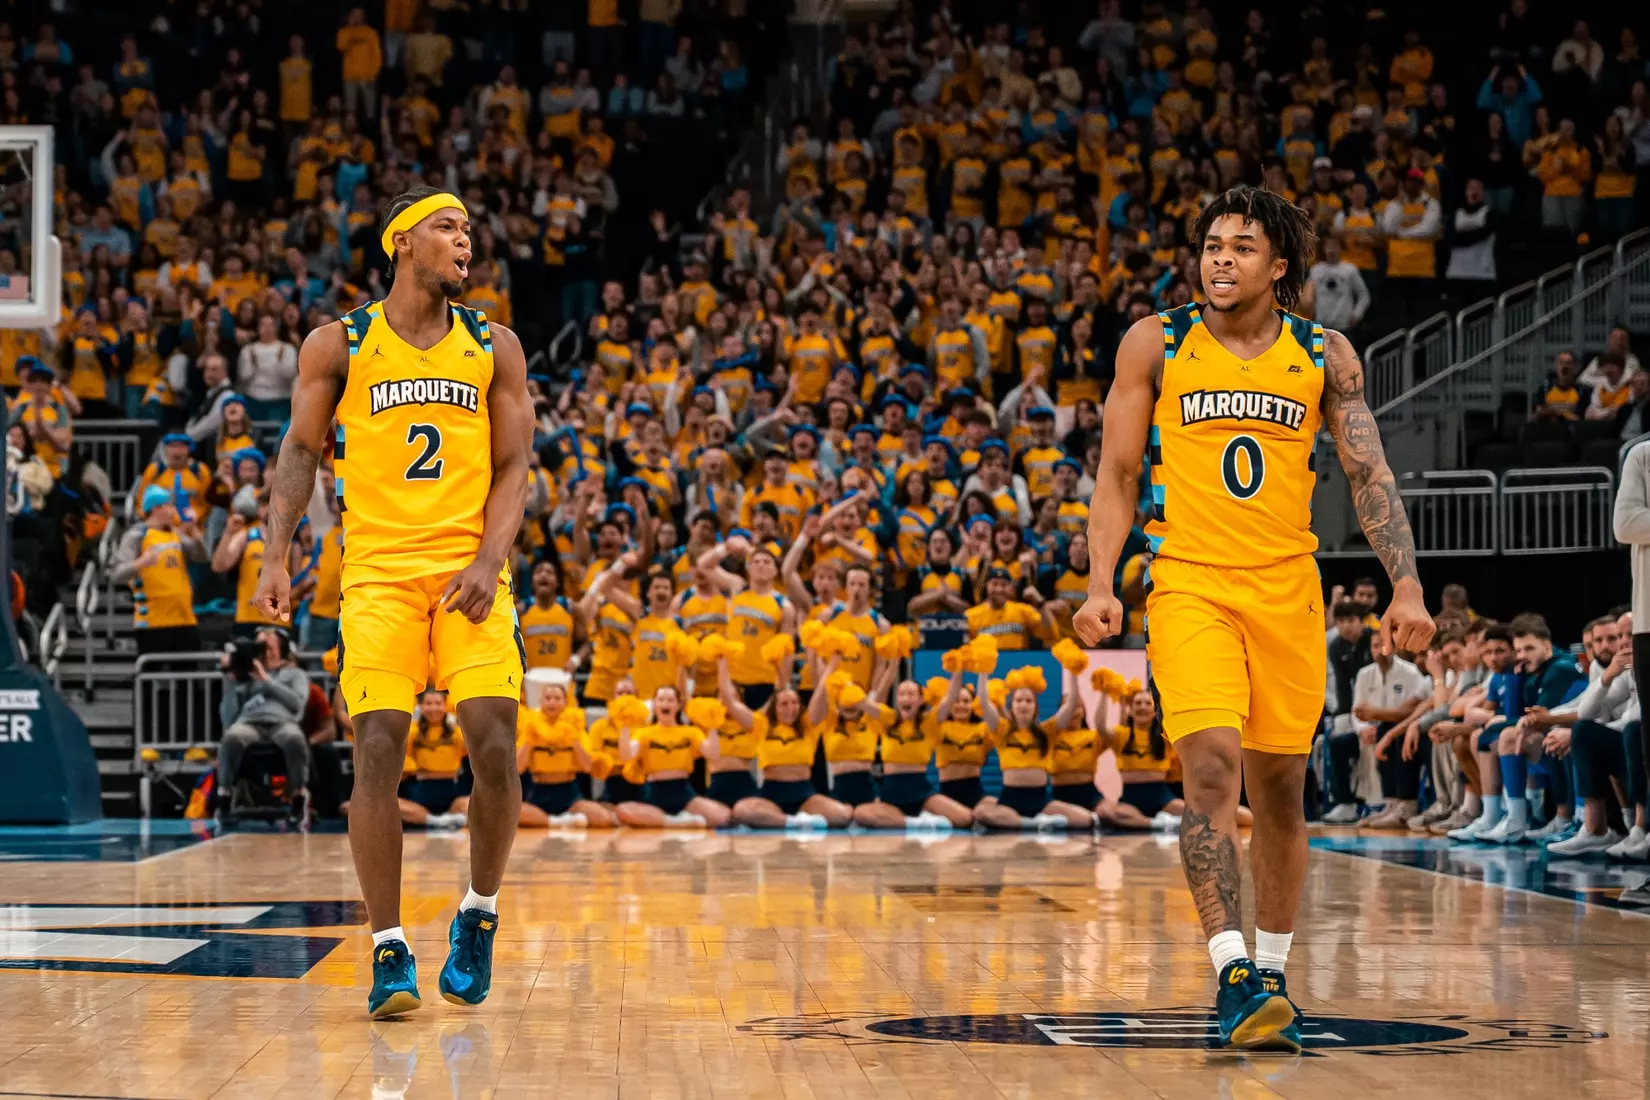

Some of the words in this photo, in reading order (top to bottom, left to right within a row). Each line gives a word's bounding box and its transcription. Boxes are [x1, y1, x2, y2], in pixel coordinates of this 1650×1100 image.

[370, 379, 479, 415] MARQUETTE
[1180, 390, 1307, 430] MARQUETTE
[404, 423, 444, 481] 2
[1221, 434, 1265, 500] 0
